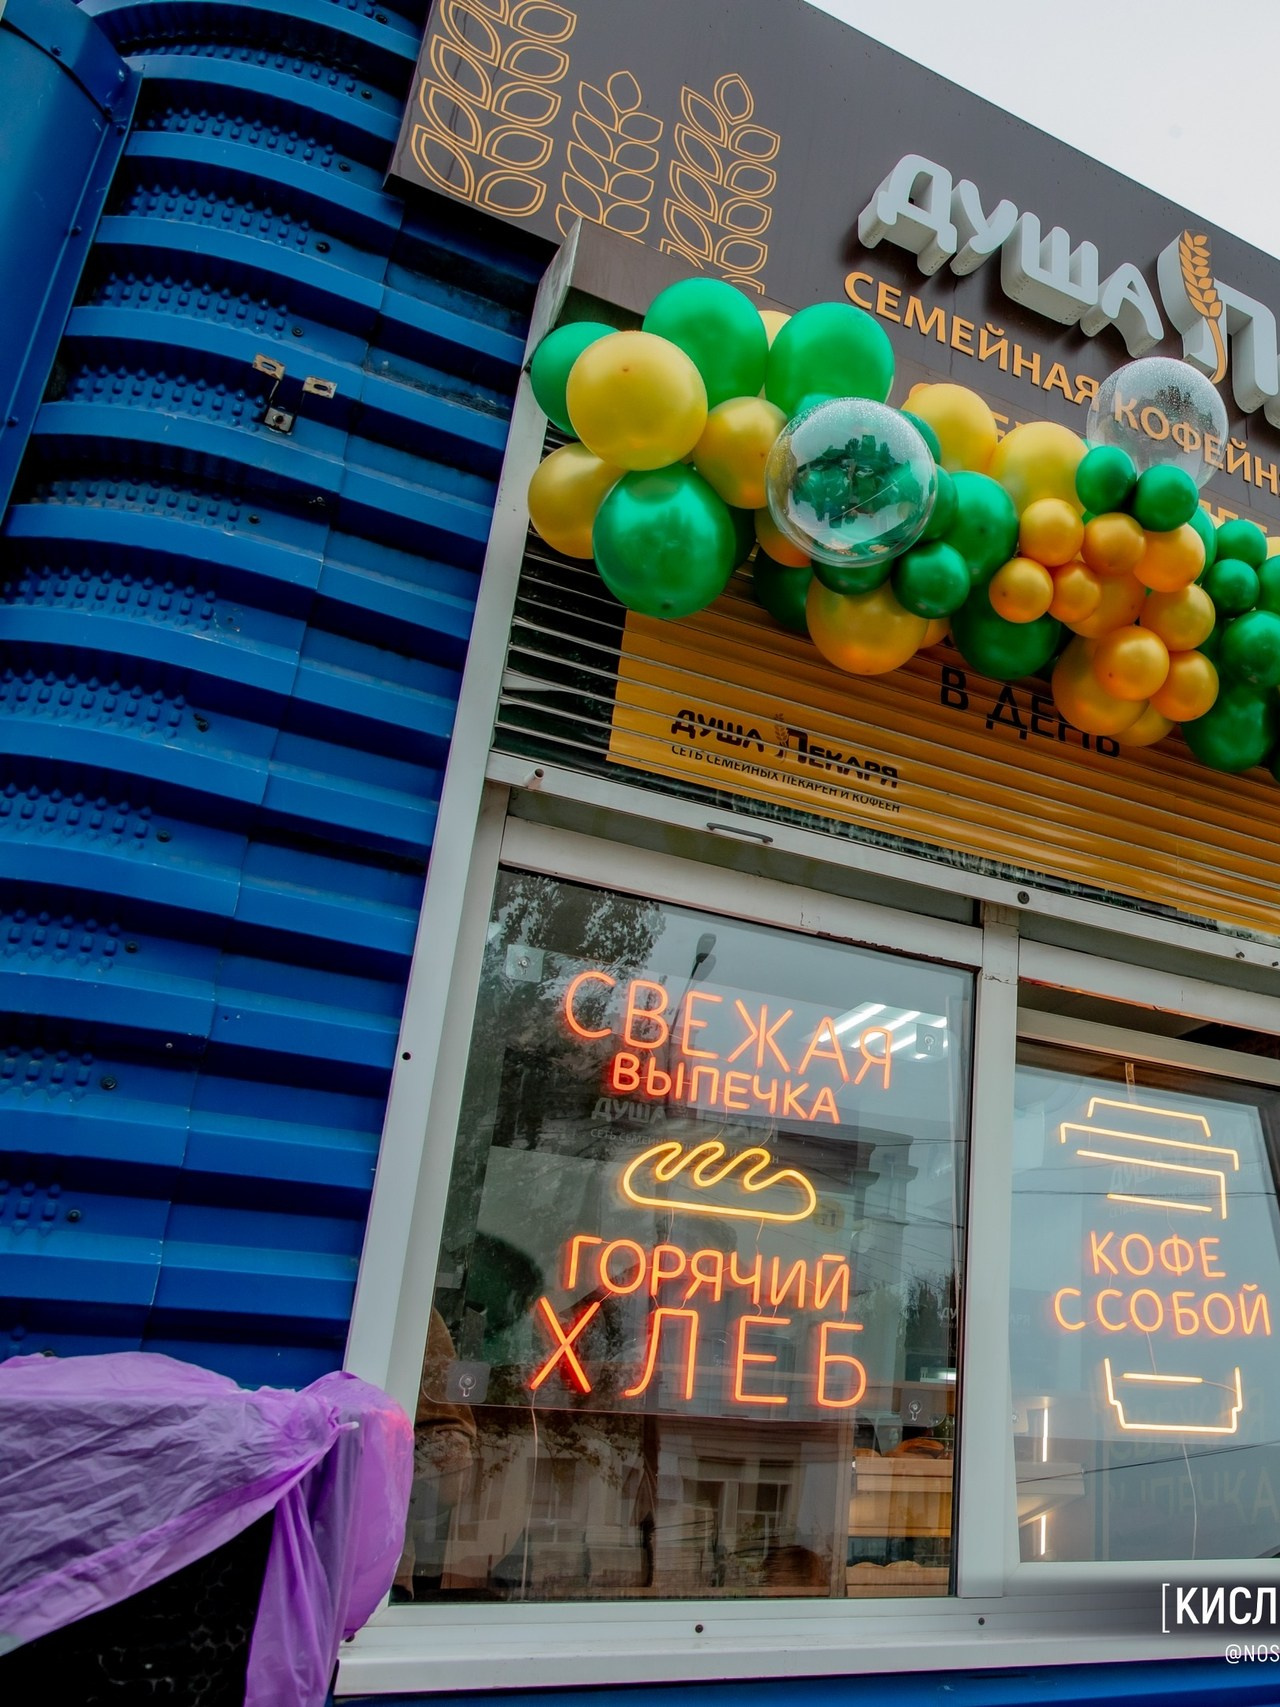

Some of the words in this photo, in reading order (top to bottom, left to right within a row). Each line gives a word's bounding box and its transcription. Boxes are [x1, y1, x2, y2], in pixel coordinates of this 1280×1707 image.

[860, 154, 1163, 356] ДУША
[844, 271, 1100, 412] СЕМЕЙНАЯ
[940, 666, 969, 711] В
[671, 709, 765, 752] ДУША
[565, 970, 894, 1090] СВЕЖАЯ
[612, 1051, 842, 1125] ВЫПЕЧКА
[567, 1236, 850, 1311] ГОРЯЧИЙ
[1090, 1230, 1227, 1280] КОФЕ
[529, 1296, 868, 1408] ХЛЕБ
